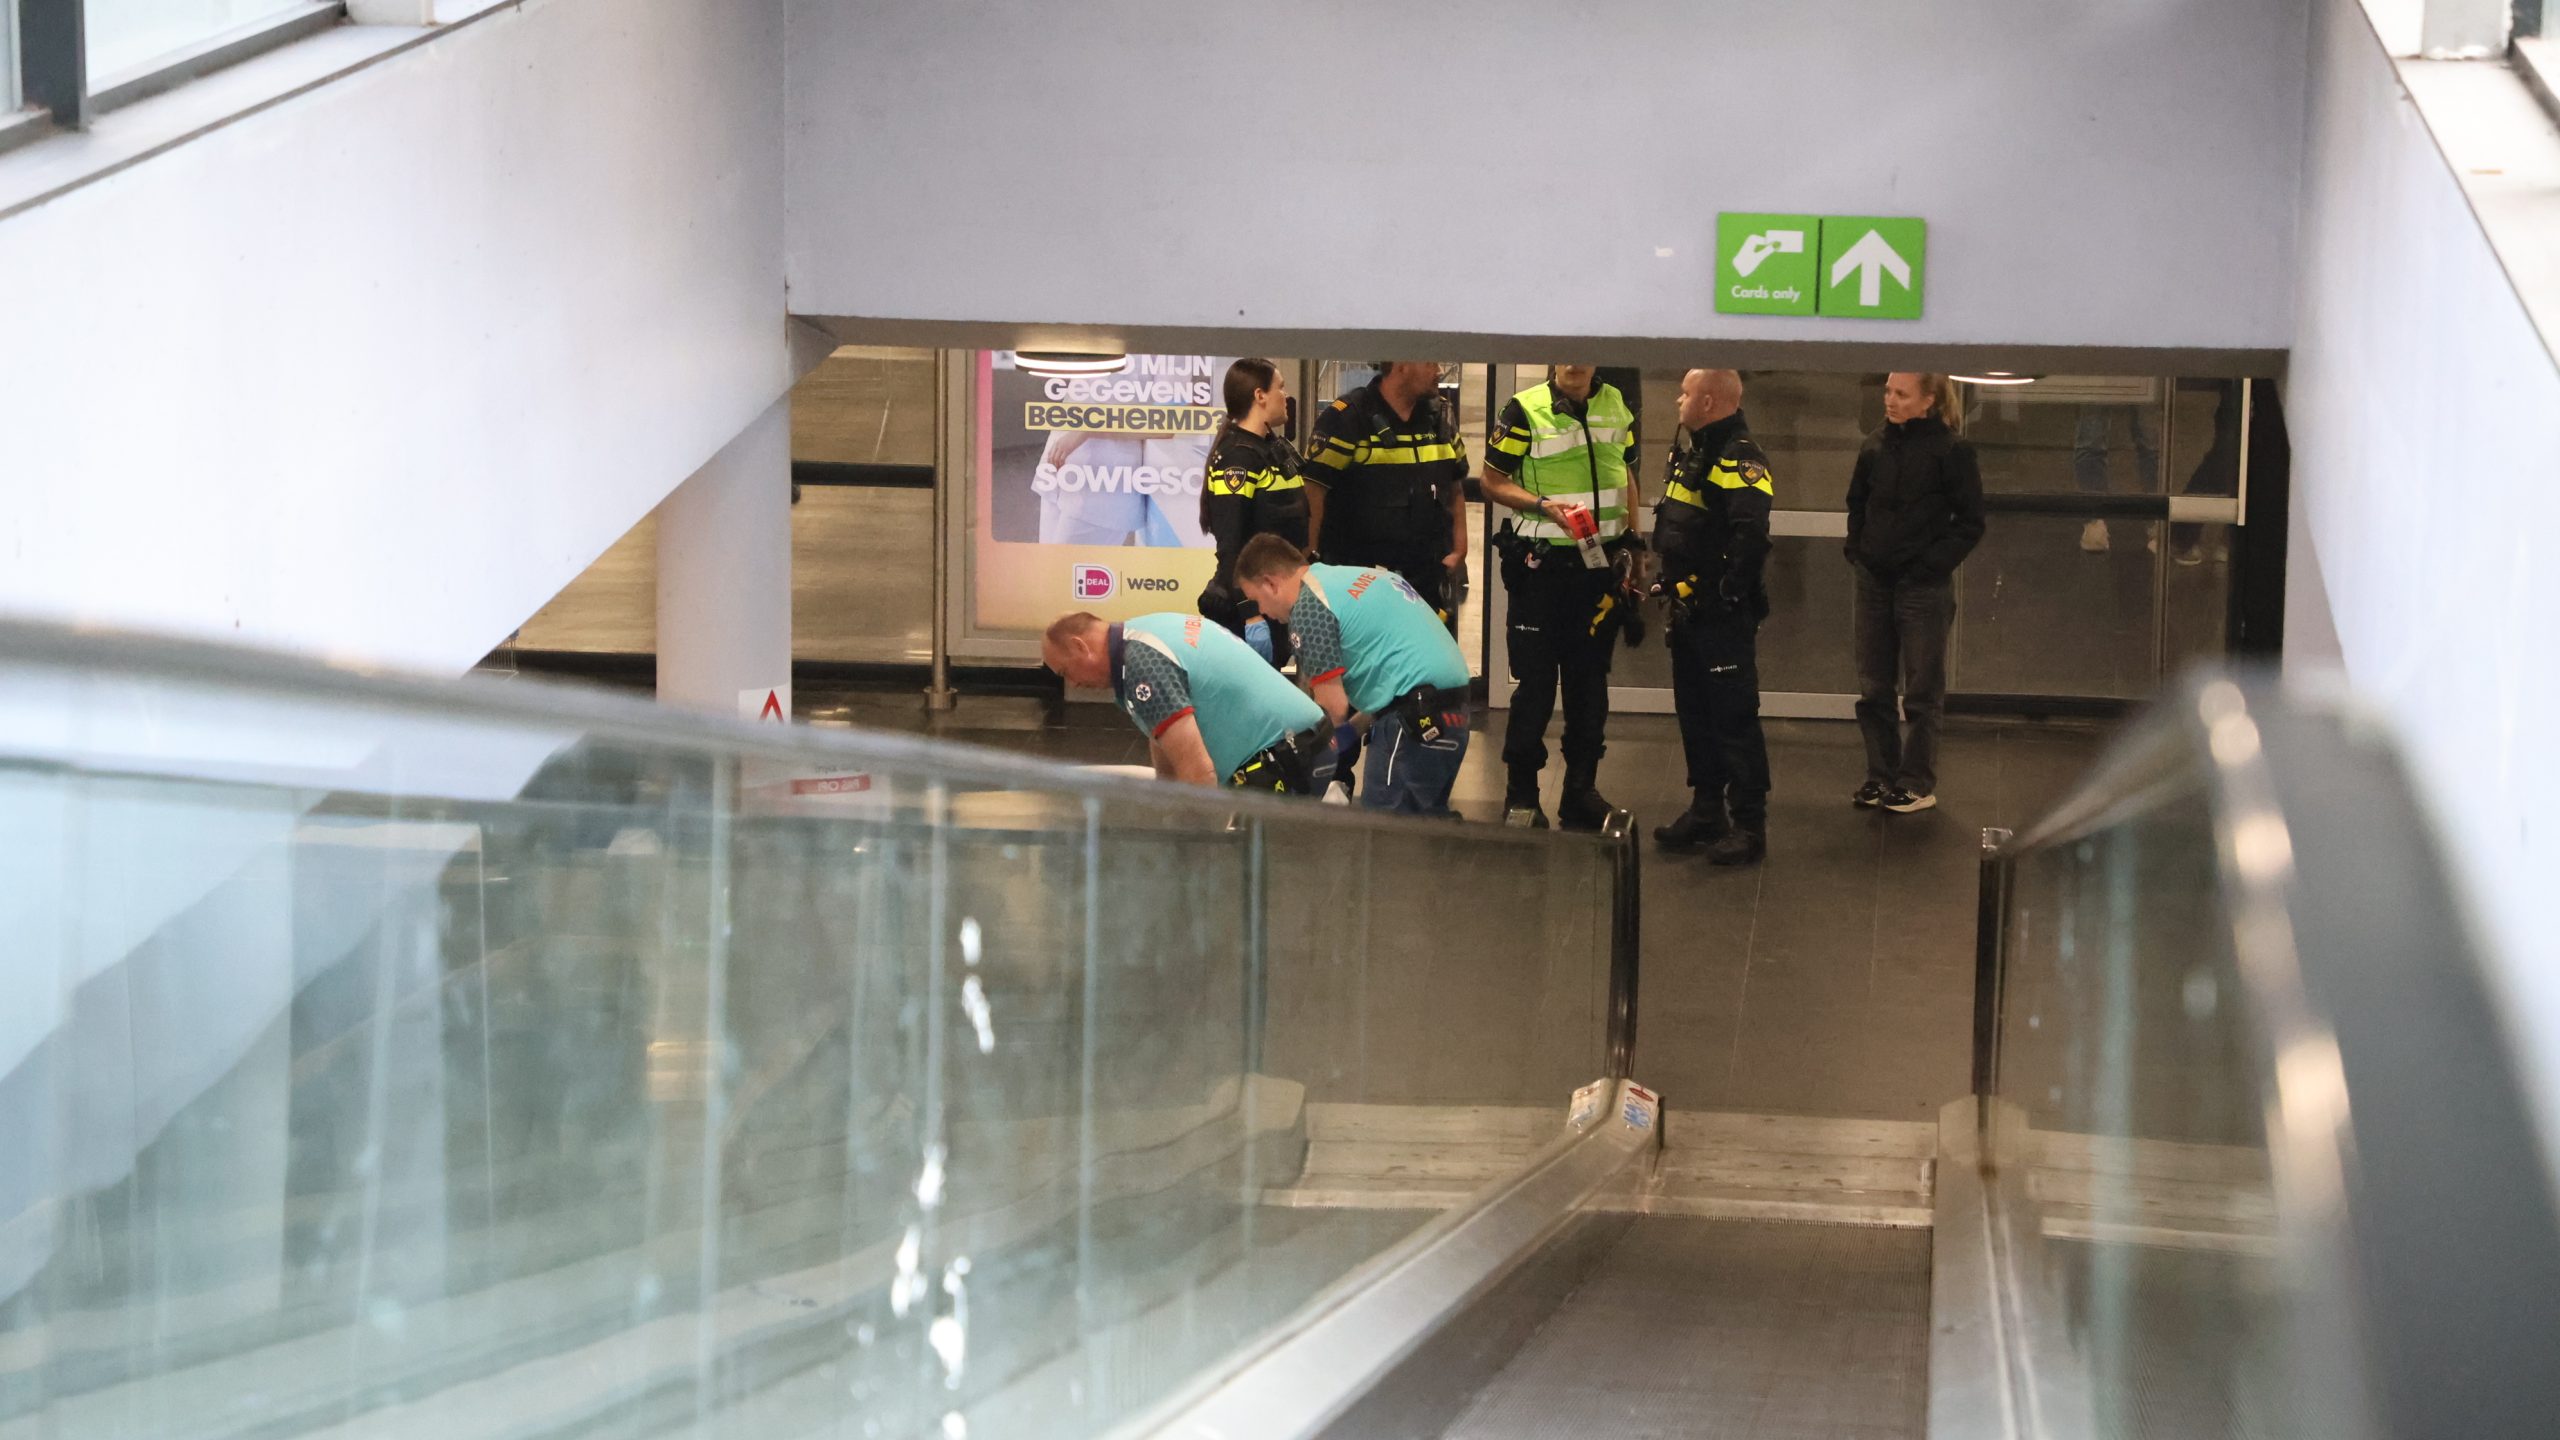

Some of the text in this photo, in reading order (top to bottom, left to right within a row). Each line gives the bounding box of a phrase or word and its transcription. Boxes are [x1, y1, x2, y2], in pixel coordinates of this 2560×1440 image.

[1731, 285, 1801, 303] Cards only
[1142, 354, 1212, 377] MIJN
